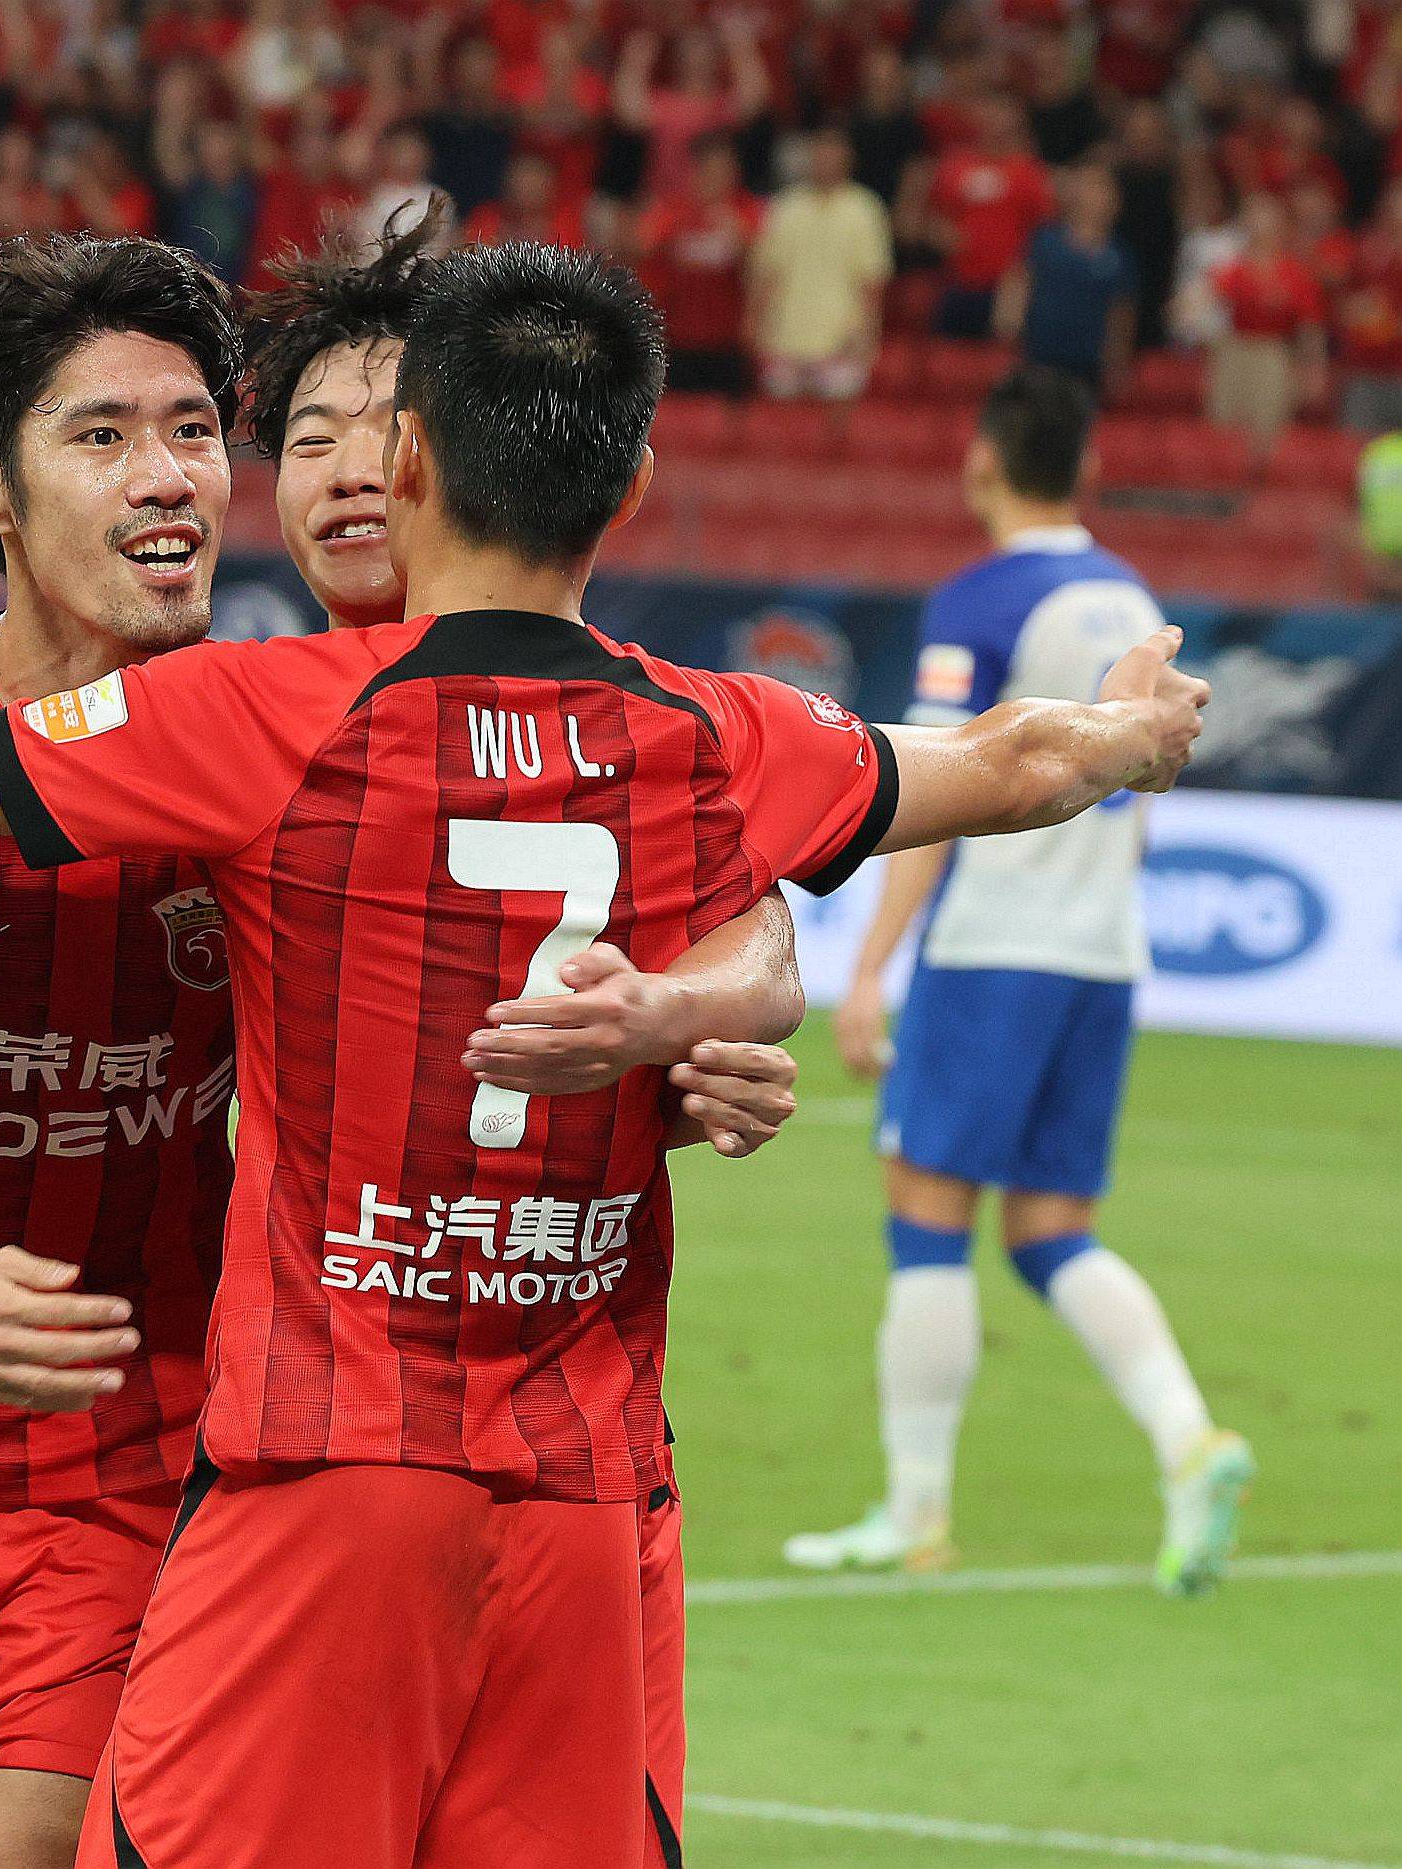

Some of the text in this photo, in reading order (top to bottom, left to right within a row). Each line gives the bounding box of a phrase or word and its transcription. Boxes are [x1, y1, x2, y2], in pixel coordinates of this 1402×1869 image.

[467, 704, 615, 779] WU L.
[448, 818, 620, 1149] 7
[323, 1183, 642, 1263] 上汽集团
[321, 1254, 628, 1306] SAIC MOTOR
